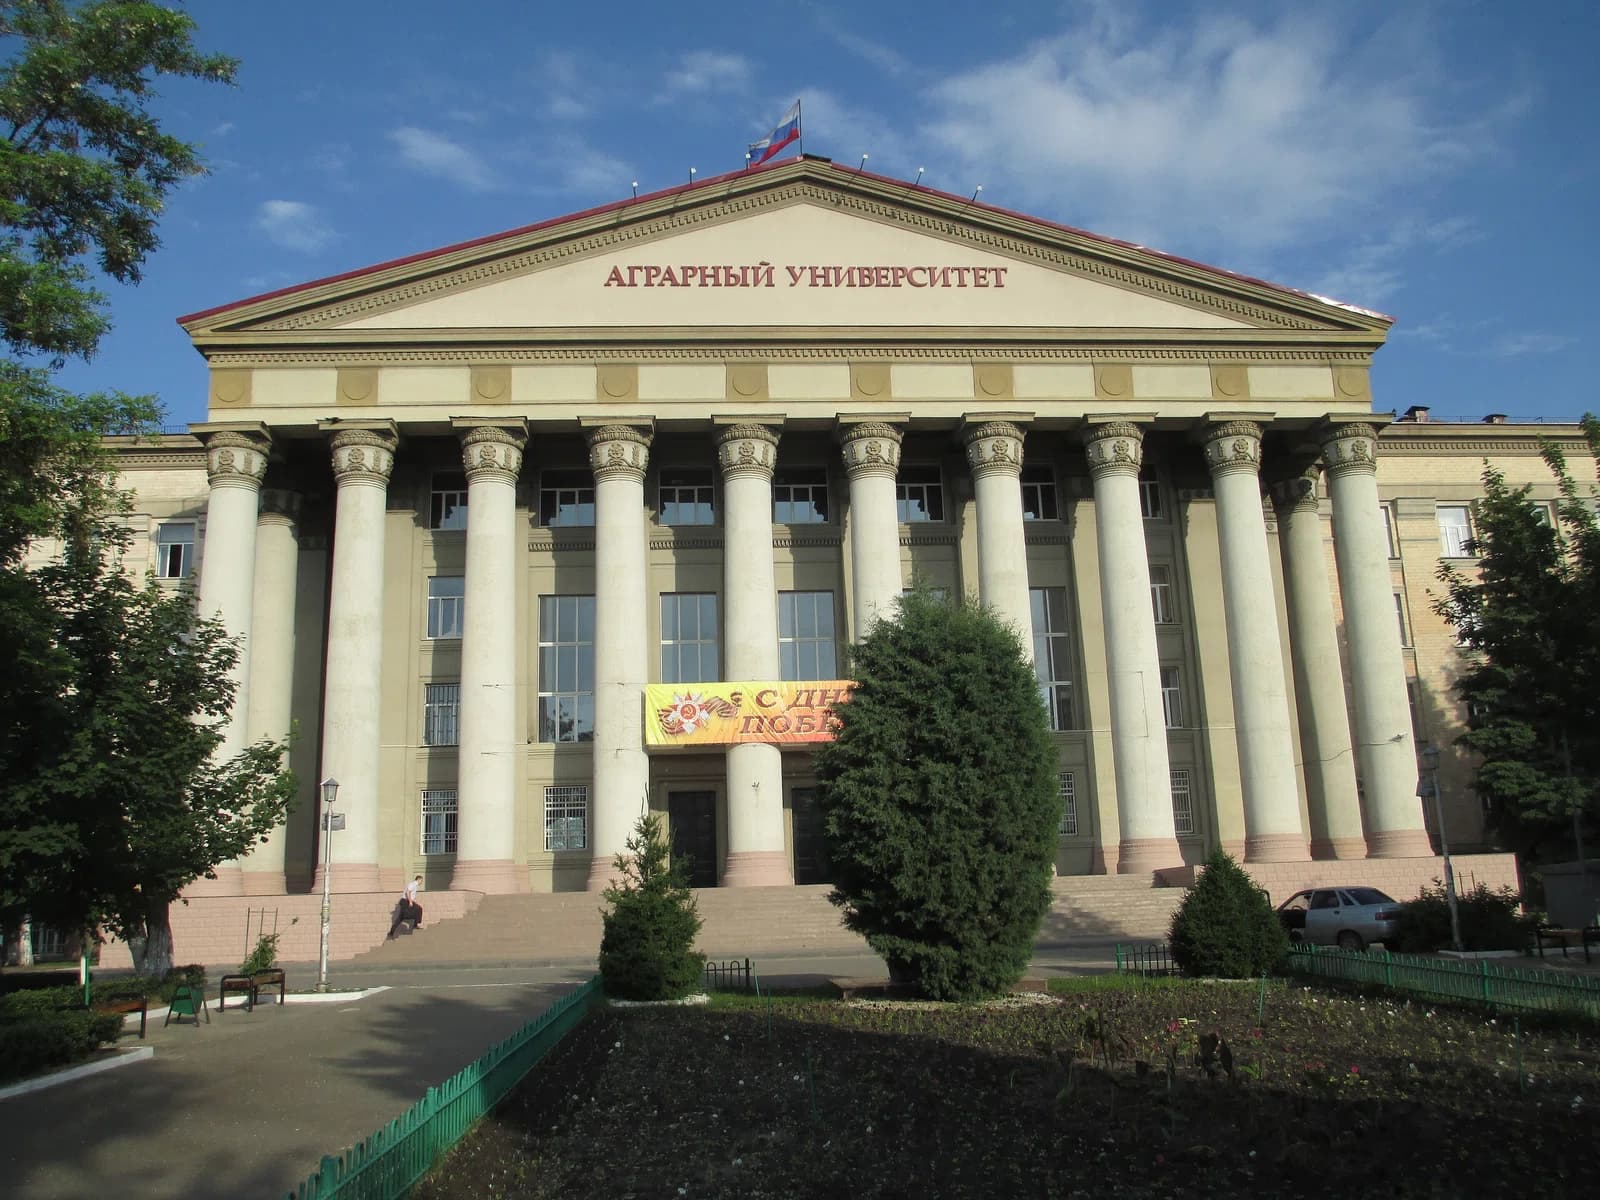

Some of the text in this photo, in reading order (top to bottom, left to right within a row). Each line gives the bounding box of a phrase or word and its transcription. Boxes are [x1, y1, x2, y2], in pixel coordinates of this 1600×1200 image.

[603, 261, 1008, 288] АГРАРНЫЙ УНИВЕРСИТЕТ
[755, 688, 847, 710] С ДН
[739, 714, 839, 734] ПОБЕ
